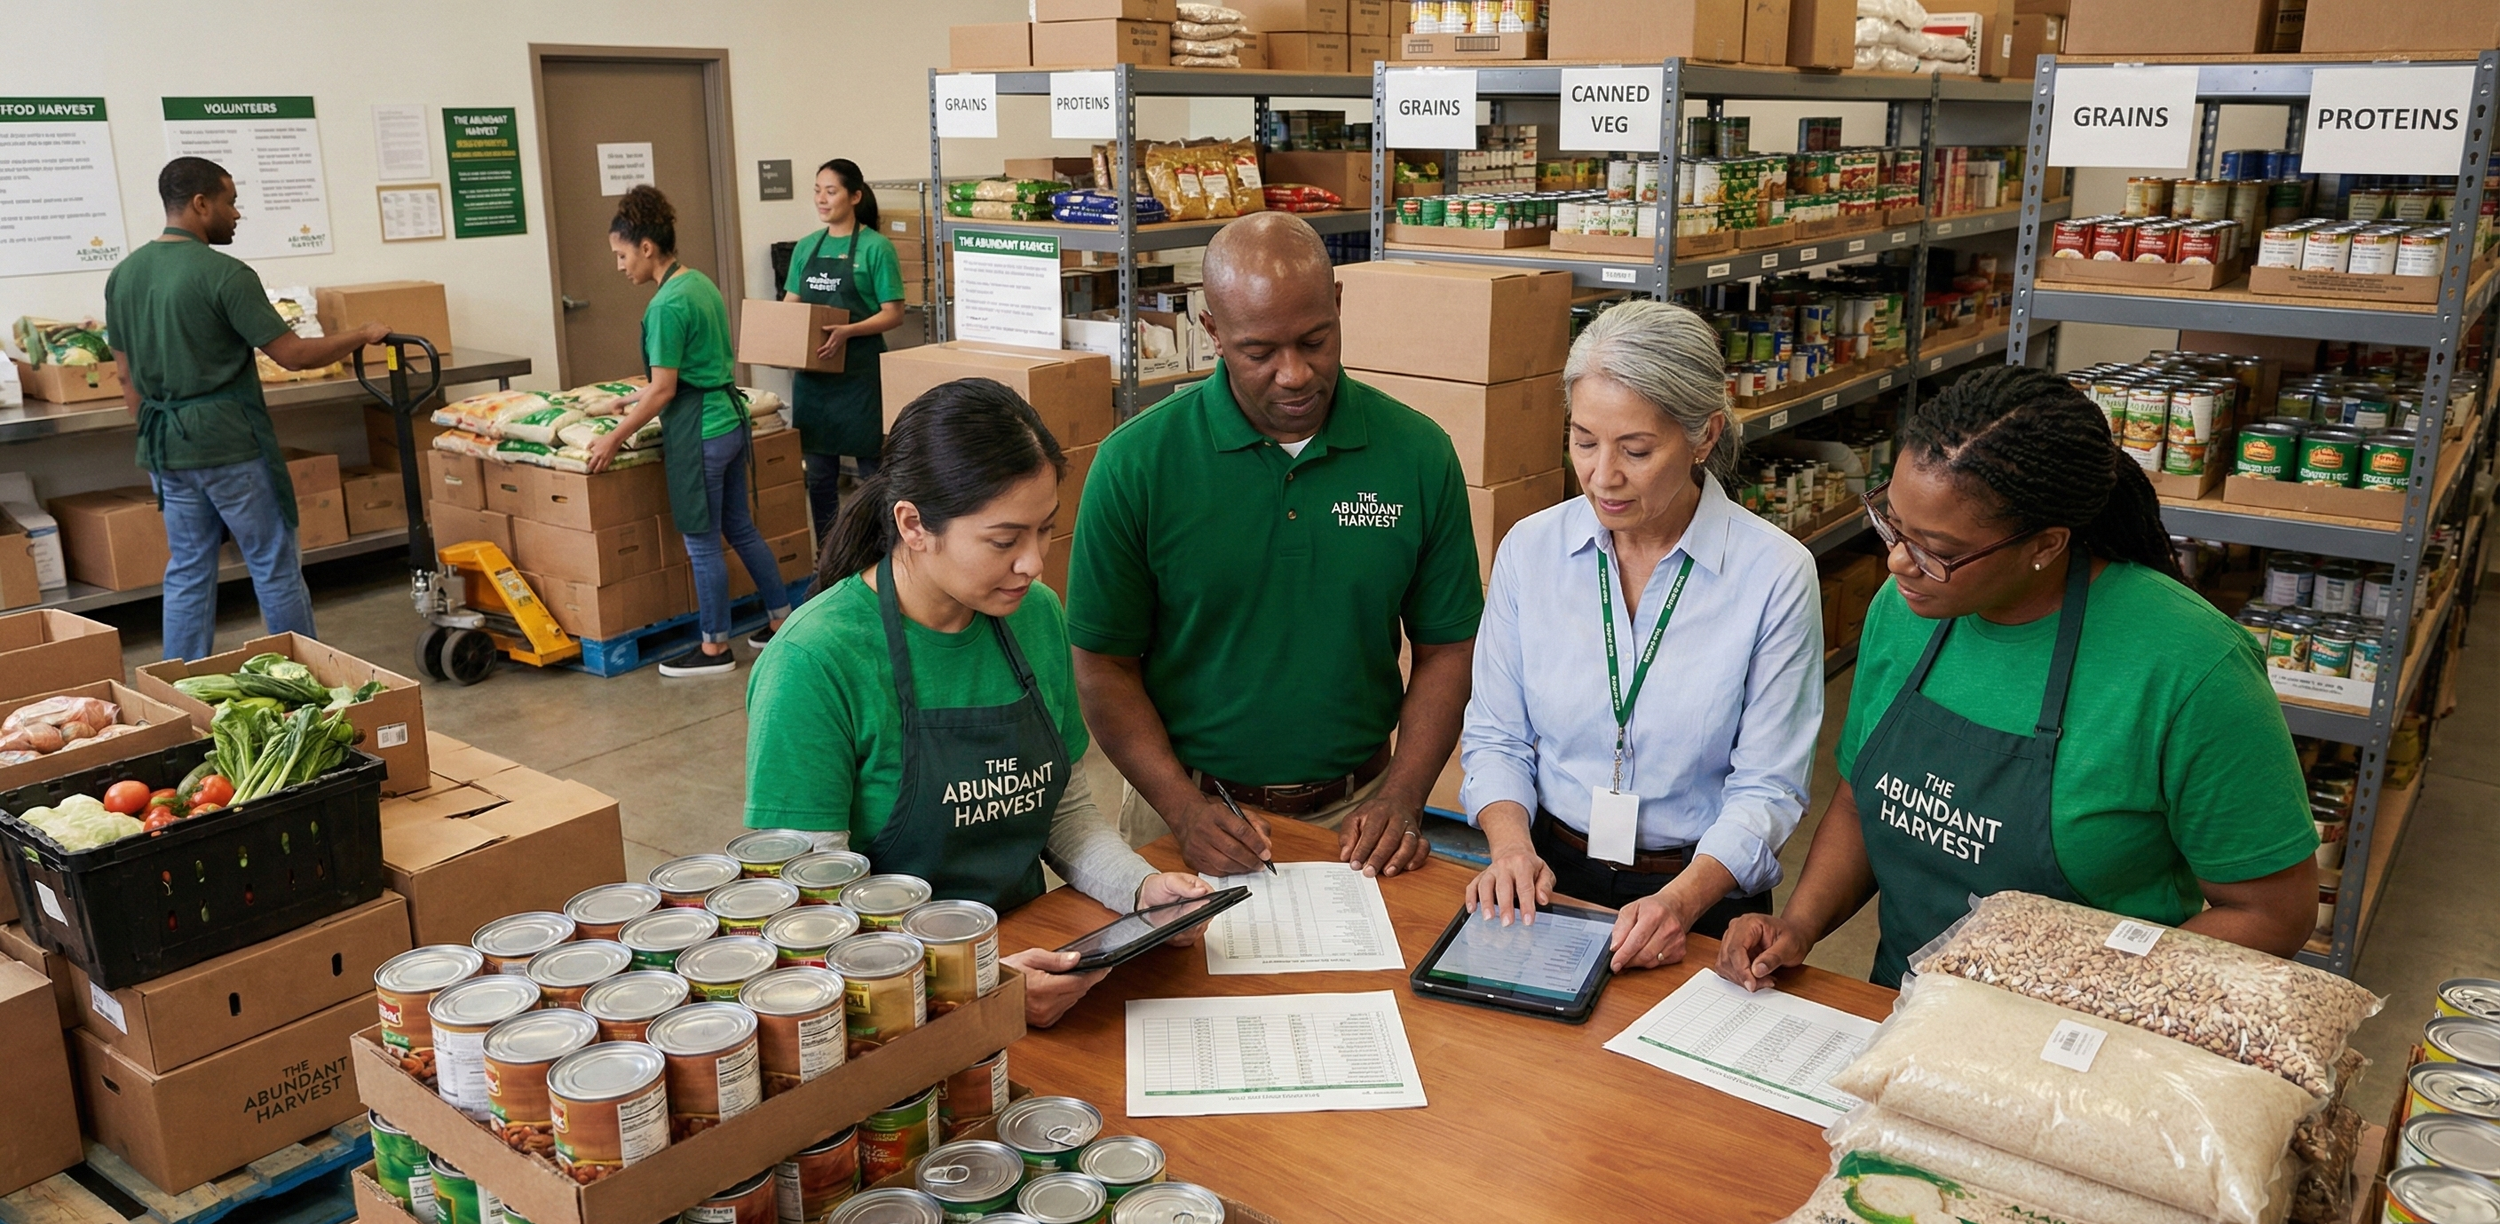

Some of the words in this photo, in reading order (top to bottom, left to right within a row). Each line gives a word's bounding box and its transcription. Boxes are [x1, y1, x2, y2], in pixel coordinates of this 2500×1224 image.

[1571, 85, 1650, 103] CANNED
[204, 103, 277, 114] VOLUNTEERS
[945, 98, 987, 111] GRAINS
[1057, 97, 1110, 110] PROTEINS
[1399, 100, 1460, 116] GRAINS
[1591, 116, 1628, 133] VEG
[2073, 106, 2169, 128] GRAINS
[2317, 108, 2459, 131] PROTEINS
[959, 236, 974, 247] THE
[1357, 492, 1378, 502] THE
[1331, 502, 1403, 516] ABUNDANT
[1338, 515, 1398, 528] HARVEST
[985, 757, 1017, 774] THE
[942, 761, 1053, 804] ABUNDANT
[1924, 772, 1955, 799] THE
[955, 788, 1045, 827] HARVEST
[1874, 772, 2002, 843] ABUNDANT
[1880, 800, 1985, 864] HARVEST
[282, 1059, 310, 1078] THE
[243, 1056, 348, 1113] ABUNDANT
[256, 1075, 342, 1124] HARVEST
